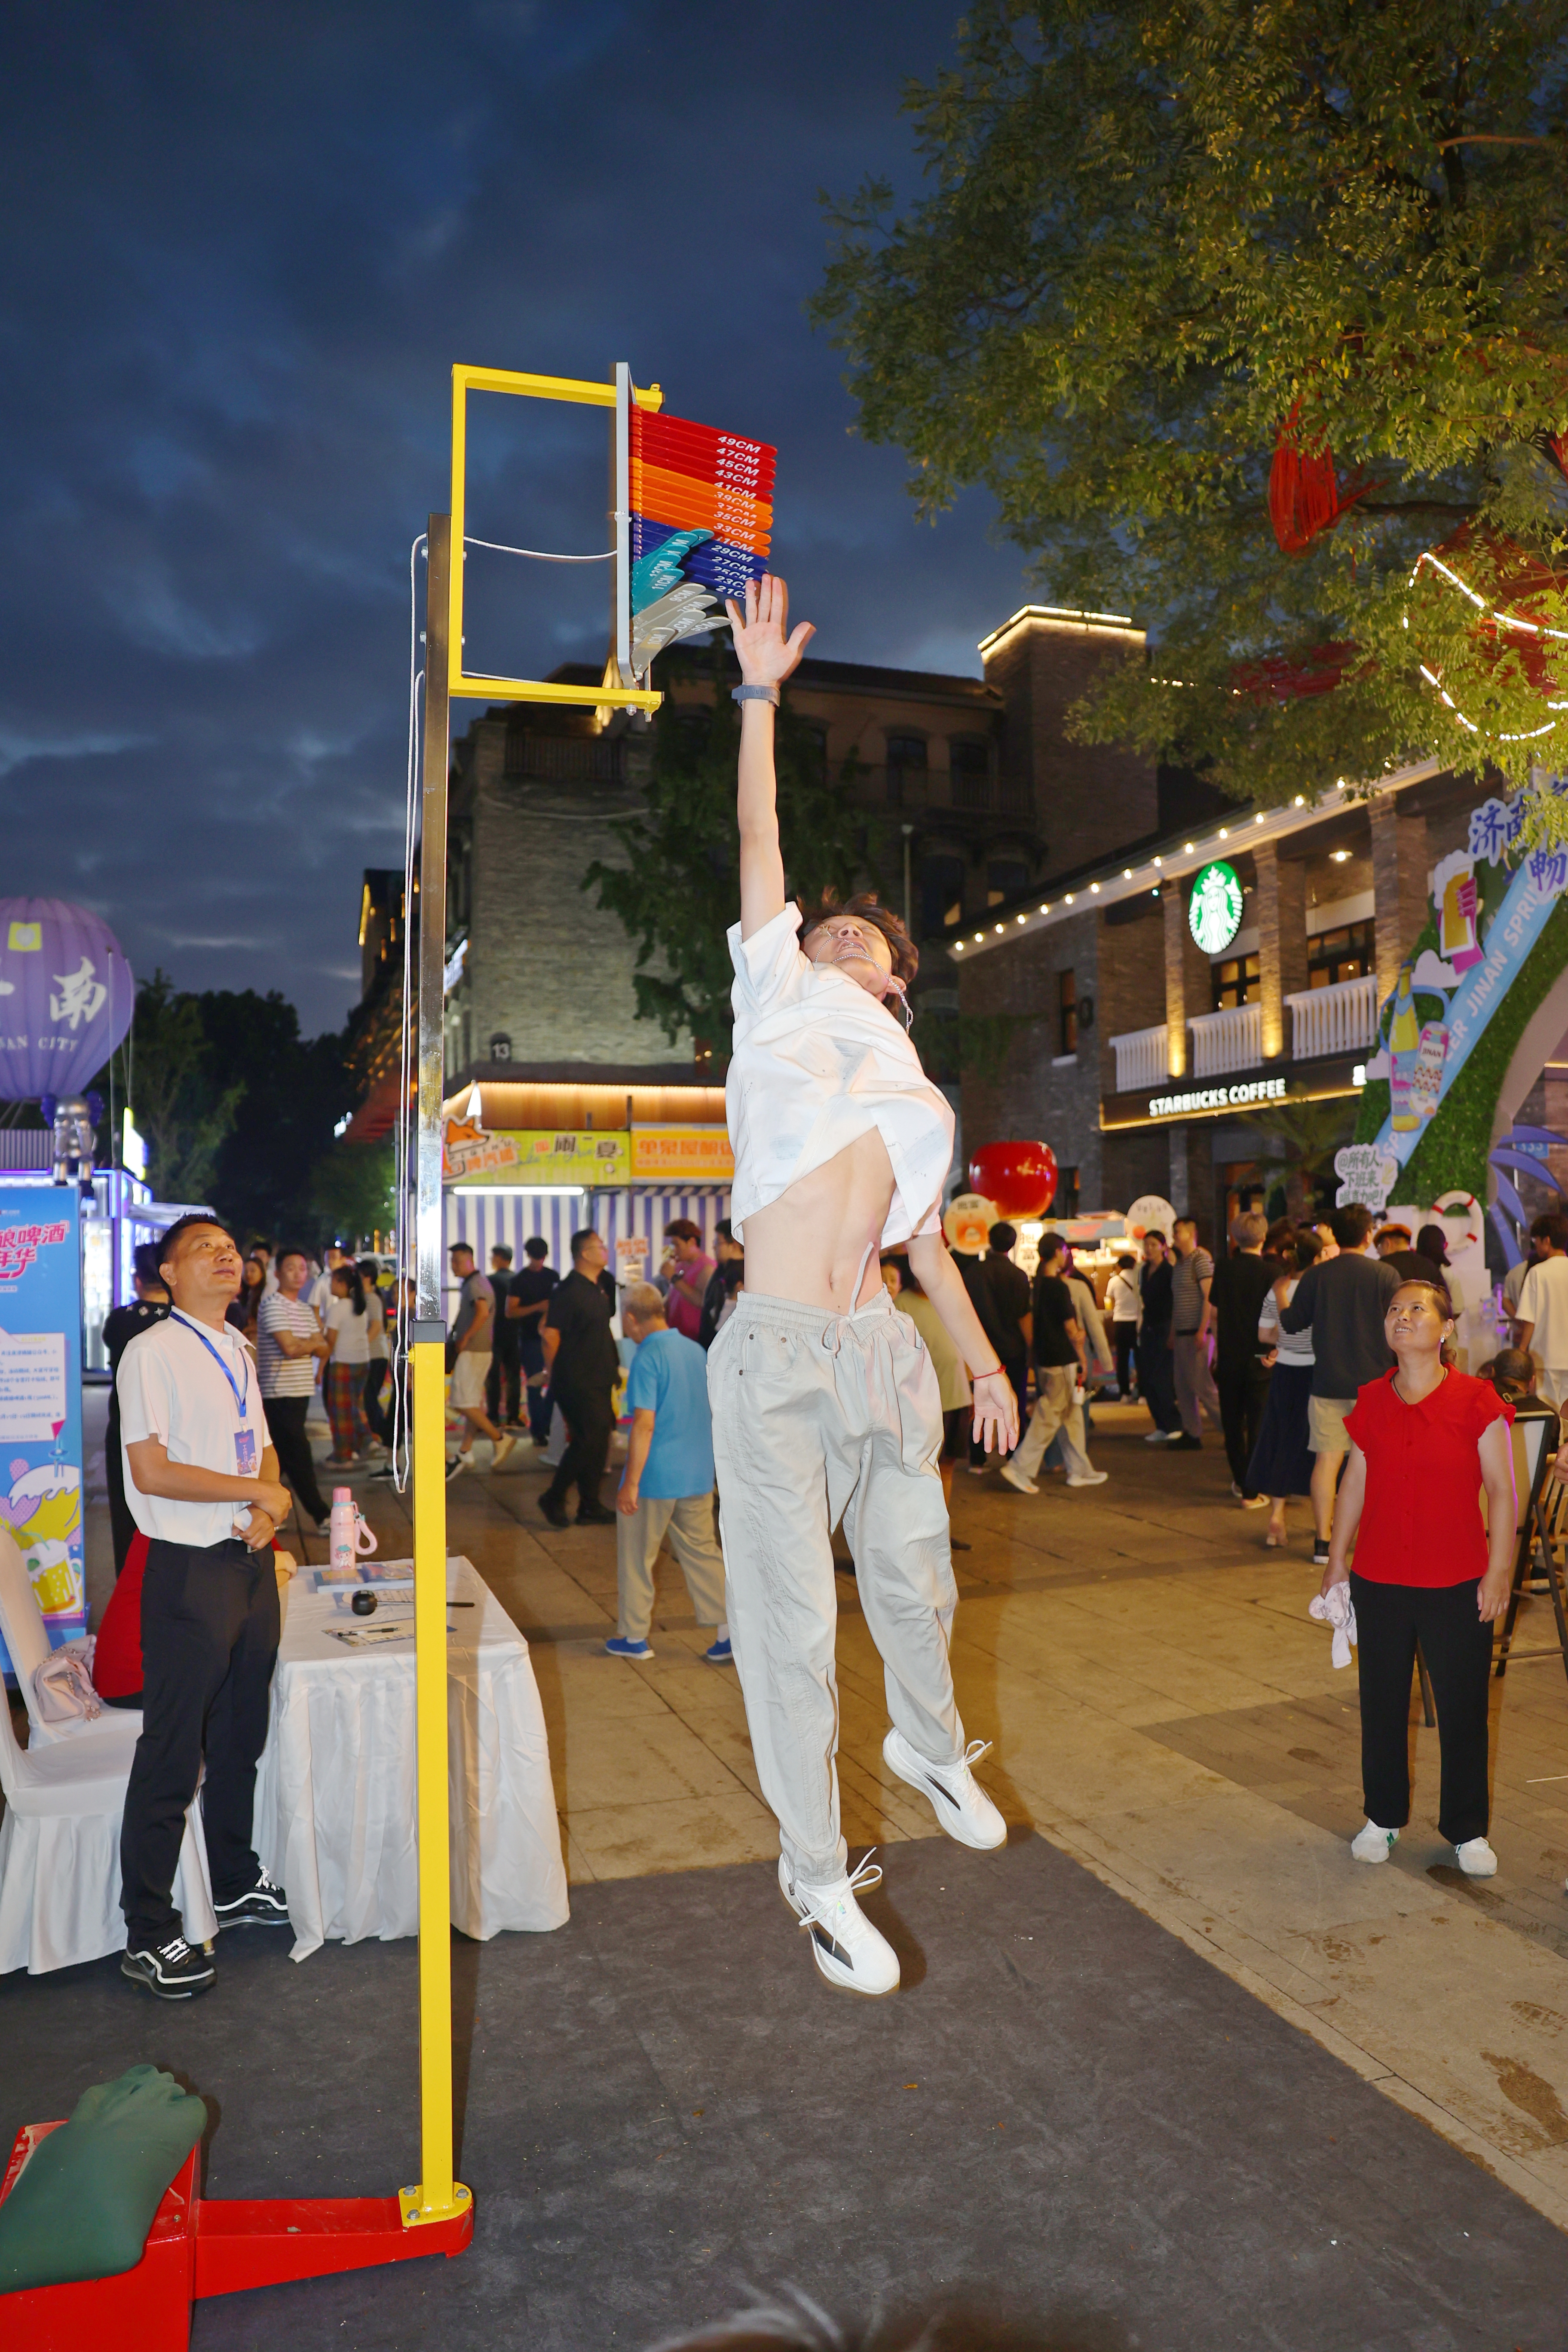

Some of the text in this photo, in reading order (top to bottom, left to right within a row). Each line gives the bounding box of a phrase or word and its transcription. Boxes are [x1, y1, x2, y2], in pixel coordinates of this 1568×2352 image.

[718, 436, 761, 453] 49CM
[717, 448, 760, 465] 47CM
[717, 458, 760, 476] 45CM
[715, 470, 758, 487] 43CM
[714, 482, 756, 499] 41CM
[714, 492, 756, 510] 39CM
[714, 511, 756, 527] 35CM
[714, 523, 756, 540] 33CM
[711, 545, 754, 562] 29CM
[712, 556, 754, 573] 27CM
[711, 566, 754, 581] 25CM
[652, 575, 677, 590] 11CM
[714, 576, 749, 590] 23C
[669, 590, 695, 602] 9CM
[716, 585, 749, 600] 21C
[677, 601, 706, 612] 7CM
[691, 621, 720, 631] 5CM
[647, 634, 667, 645] 1CM
[1467, 949, 1507, 1017] JINAN
[38, 1036, 78, 1052] CITY
[493, 1043, 509, 1059] 13
[1422, 1047, 1441, 1057] JINAN
[1149, 1078, 1286, 1117] STARBUCKS COFFEE
